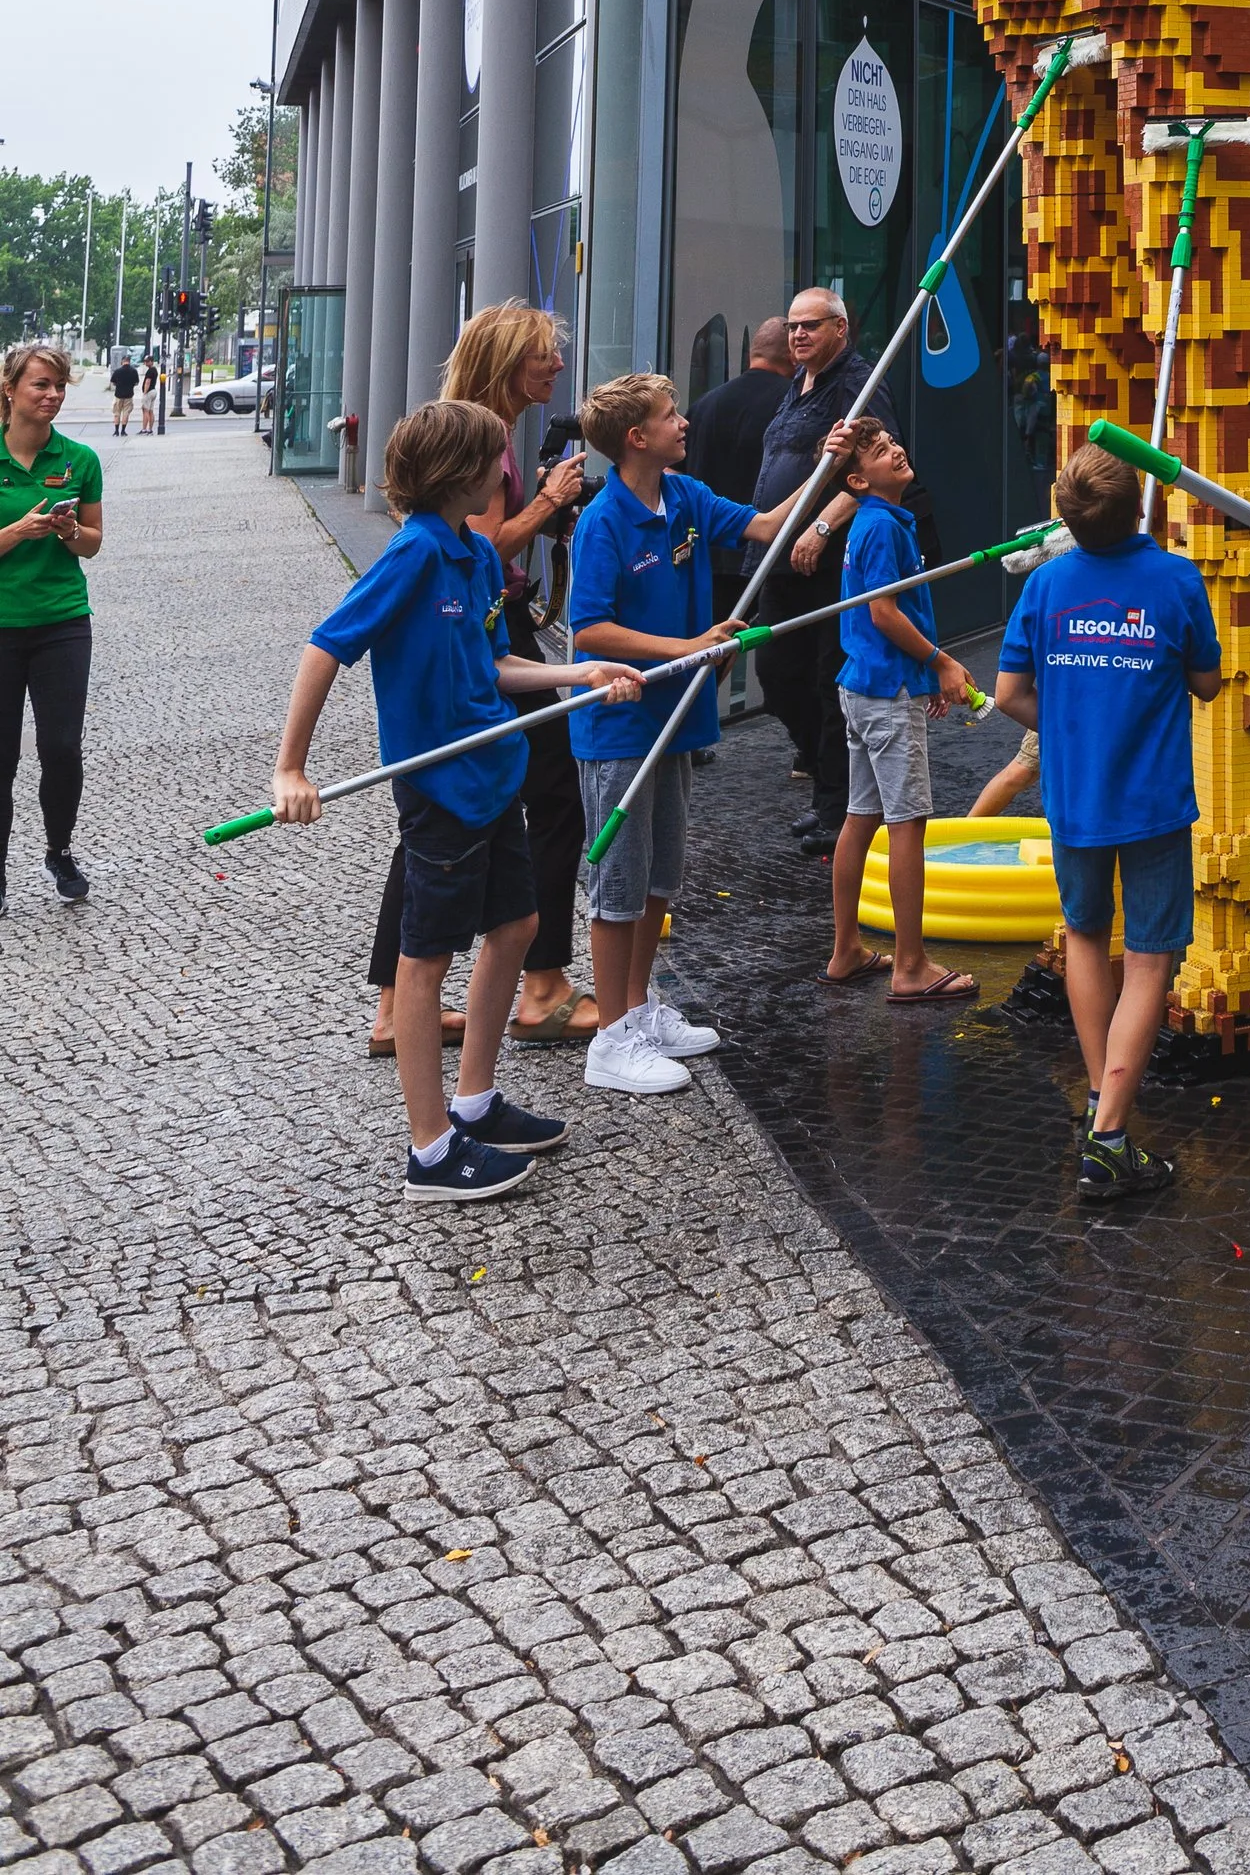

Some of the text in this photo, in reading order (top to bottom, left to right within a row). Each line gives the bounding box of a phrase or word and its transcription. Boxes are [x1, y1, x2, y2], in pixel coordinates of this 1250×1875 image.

[851, 59, 883, 87] NICHT
[848, 88, 887, 112] DEN HALS
[842, 112, 886, 136] VERBIEGEN
[840, 138, 894, 163] EINGANG UM
[850, 166, 887, 187] DIE ECKE!
[1069, 609, 1156, 639] LEGOLAND
[1046, 653, 1154, 671] CREATIVE CREW
